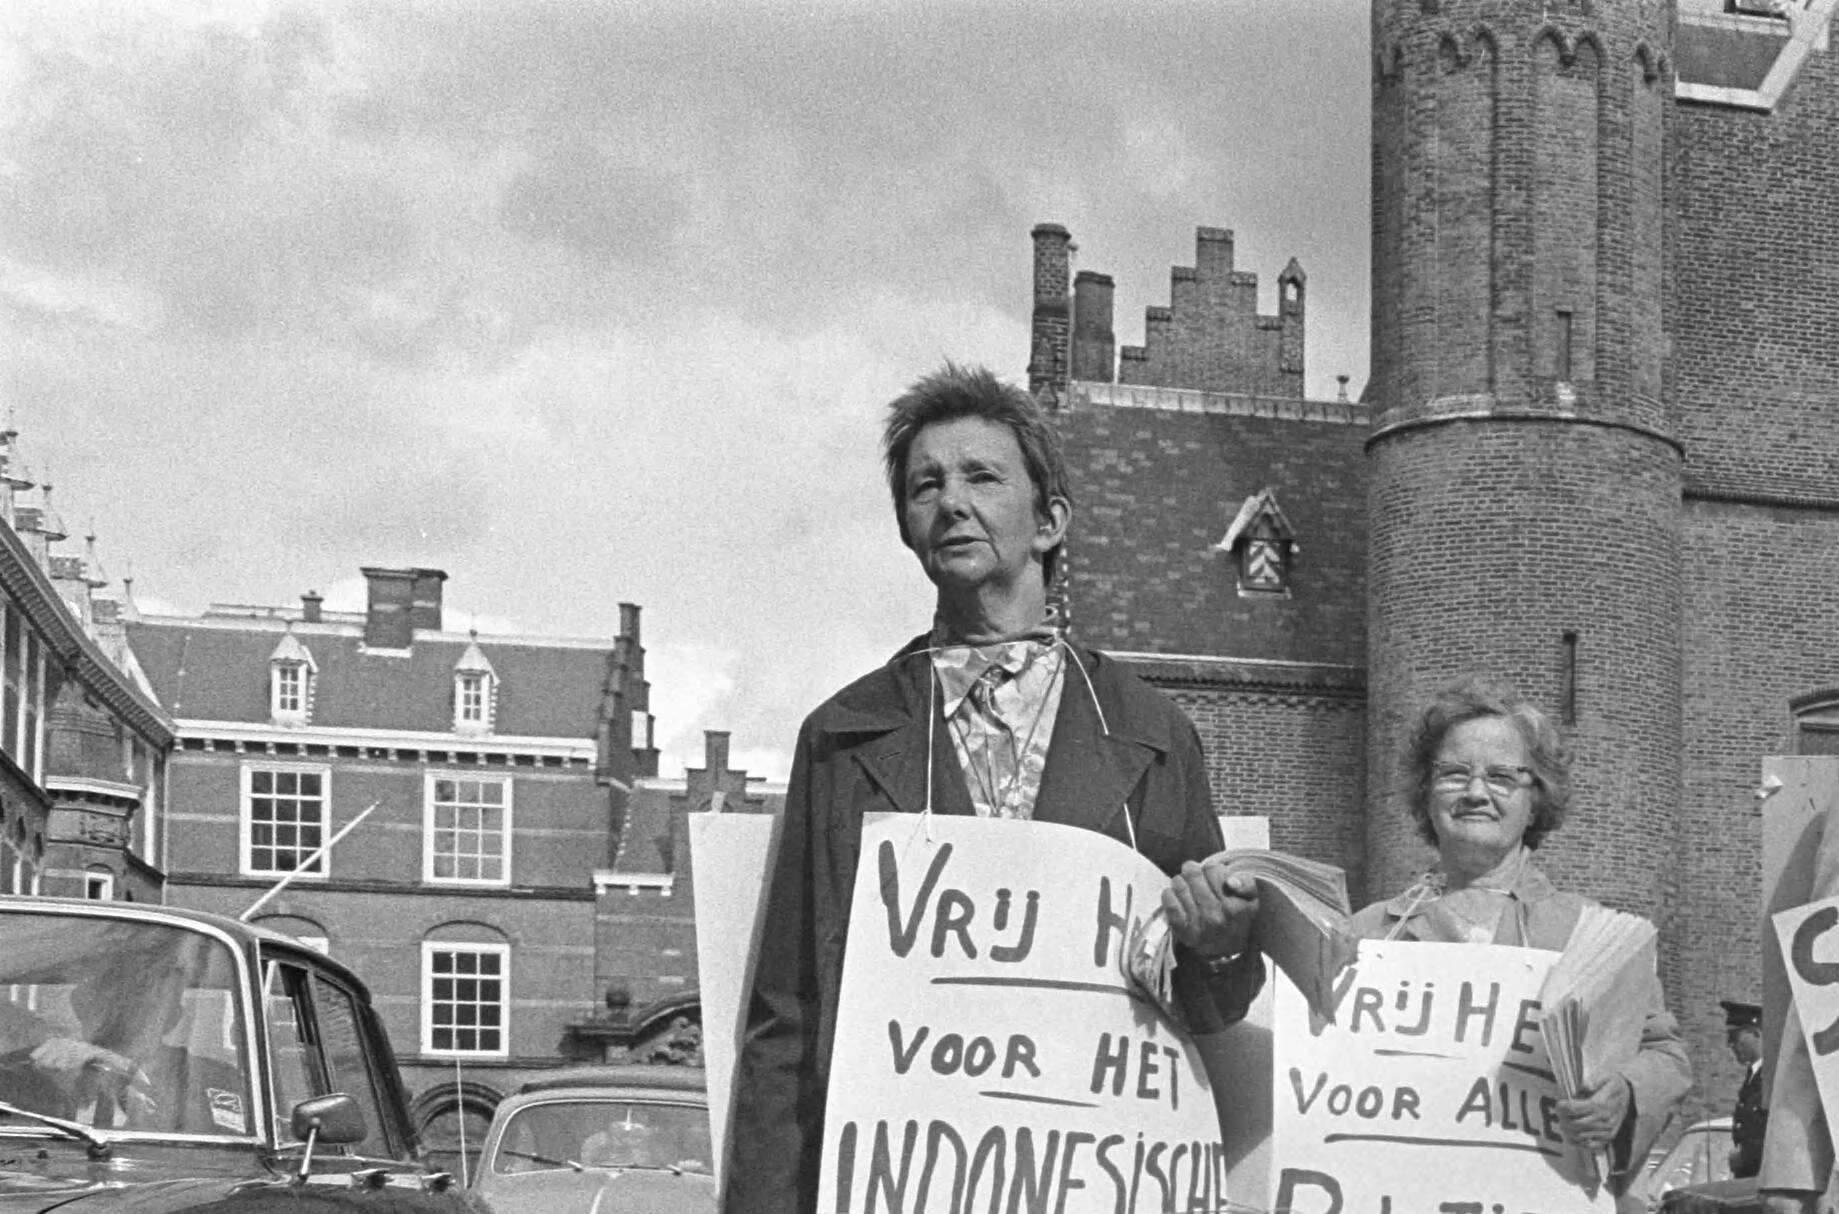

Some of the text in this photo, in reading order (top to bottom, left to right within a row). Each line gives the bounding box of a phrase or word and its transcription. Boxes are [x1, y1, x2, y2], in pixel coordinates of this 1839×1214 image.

[889, 1019, 1182, 1110] VOOR HET
[1289, 1067, 1563, 1143] VOOR ALLE
